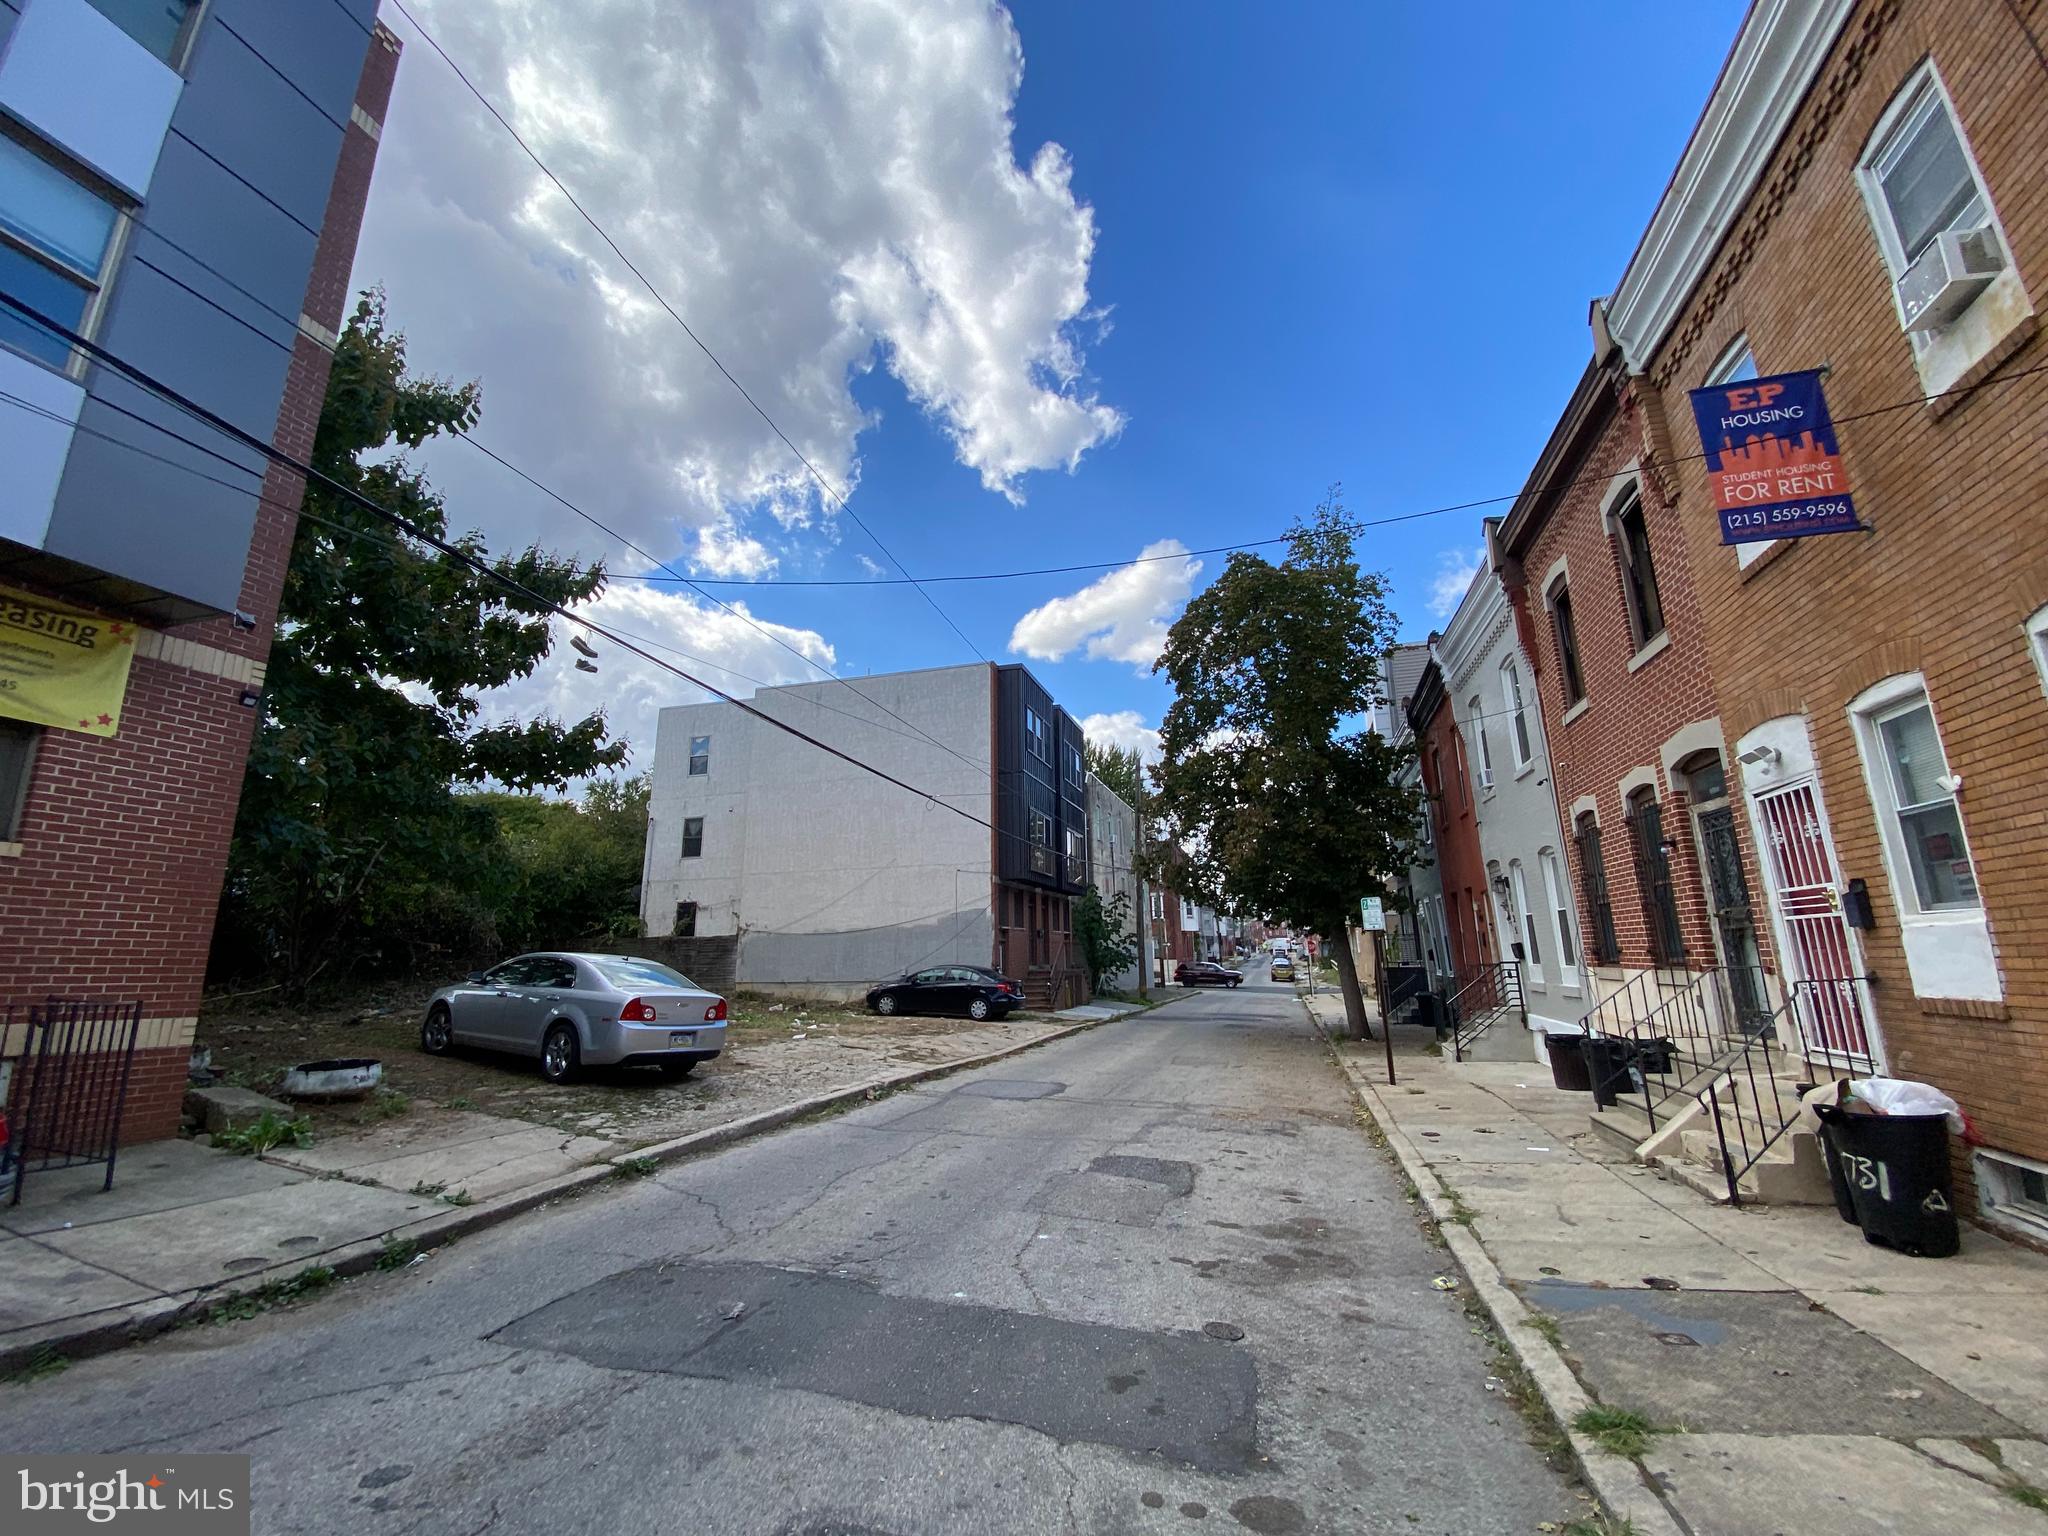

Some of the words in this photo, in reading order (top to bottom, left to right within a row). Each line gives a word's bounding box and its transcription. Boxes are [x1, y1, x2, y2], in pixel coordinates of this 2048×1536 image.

[1725, 383, 1784, 411] EP
[1721, 405, 1804, 429] HOUSING
[1722, 469, 1773, 485] STUDENT
[1775, 461, 1832, 477] HOUSING
[1724, 482, 1772, 503] FOR
[1778, 473, 1835, 496] RENT
[1727, 511, 1767, 529] (215)
[1772, 501, 1847, 523] 559-9596
[1841, 1151, 1891, 1201] 731
